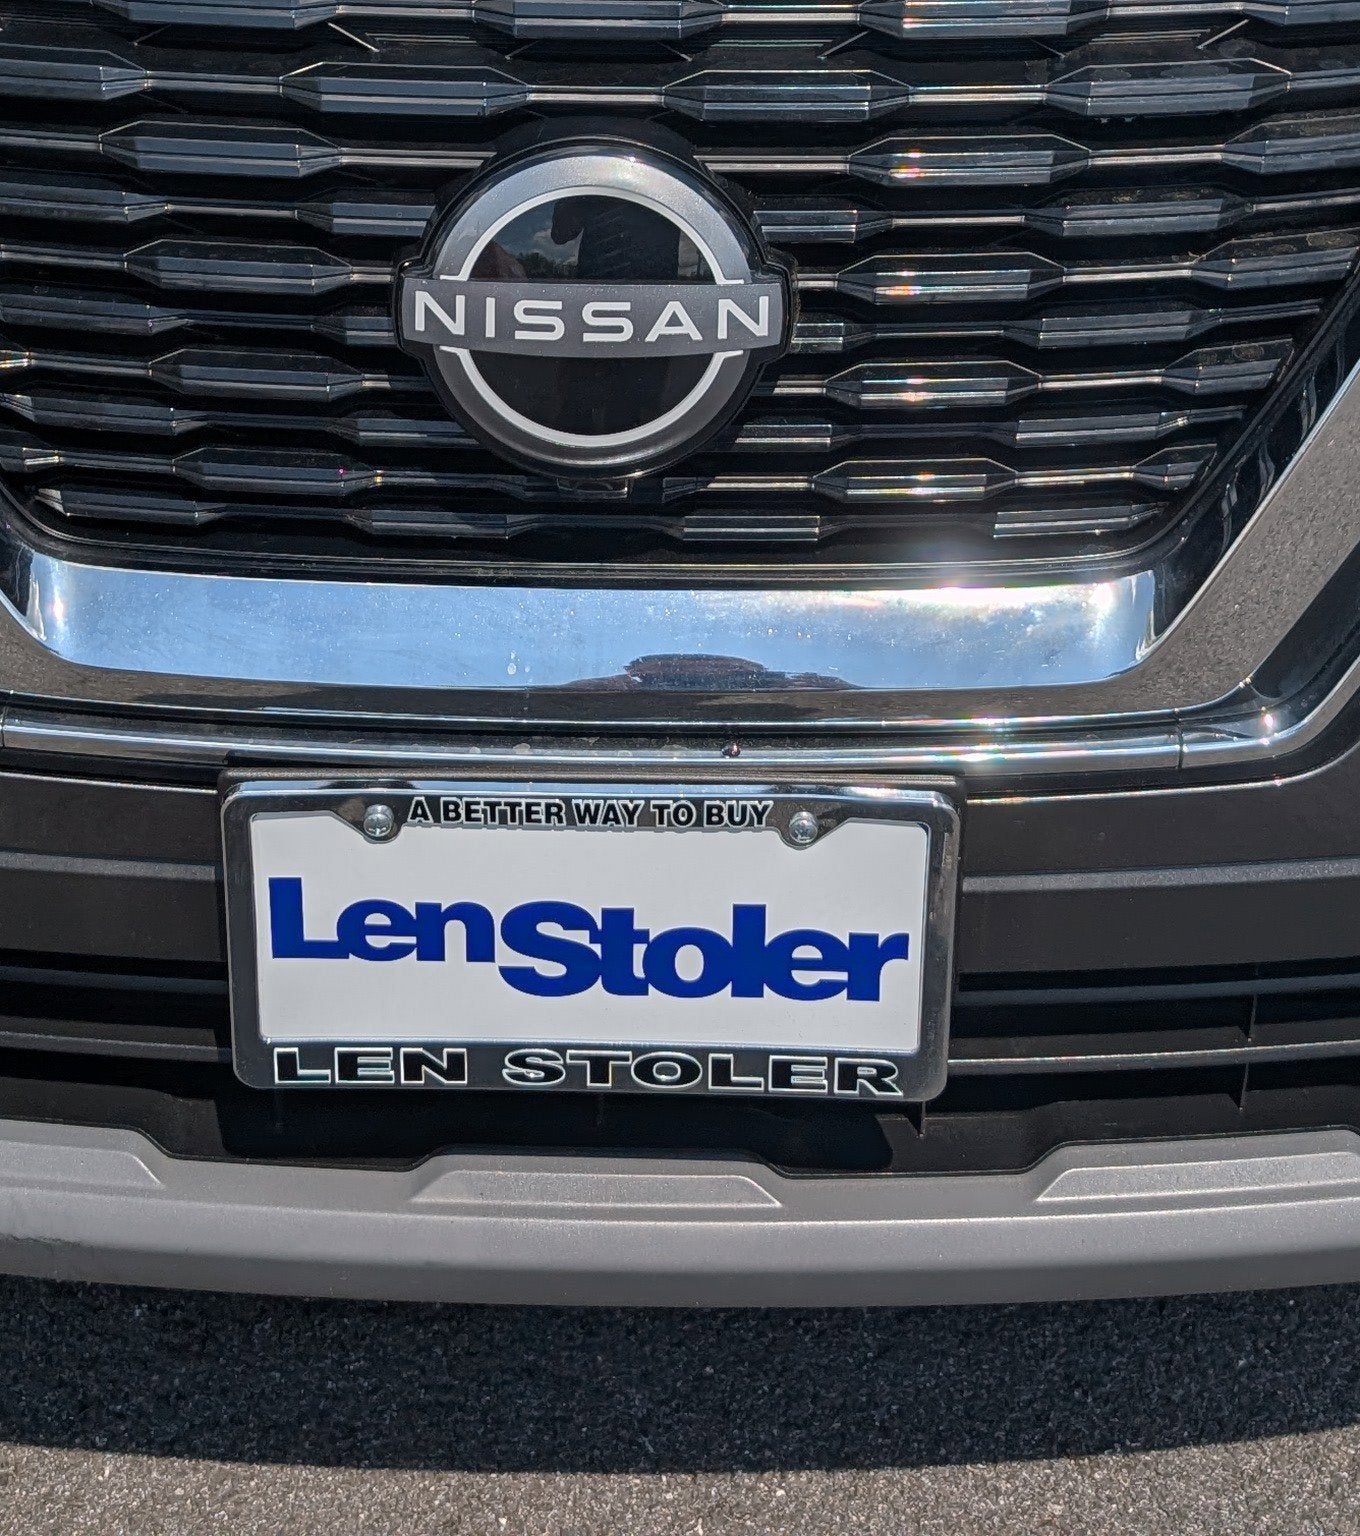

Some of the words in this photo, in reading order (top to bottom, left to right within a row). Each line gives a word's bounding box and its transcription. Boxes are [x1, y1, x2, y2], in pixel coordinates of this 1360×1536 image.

[414, 290, 770, 343] NISSAN
[408, 797, 433, 824] A
[440, 797, 564, 826] BETTER
[571, 799, 643, 827] WAY
[650, 801, 696, 827] TO
[703, 800, 774, 828] BUY
[273, 1047, 468, 1086] LEN
[502, 1049, 904, 1096] STOLER
